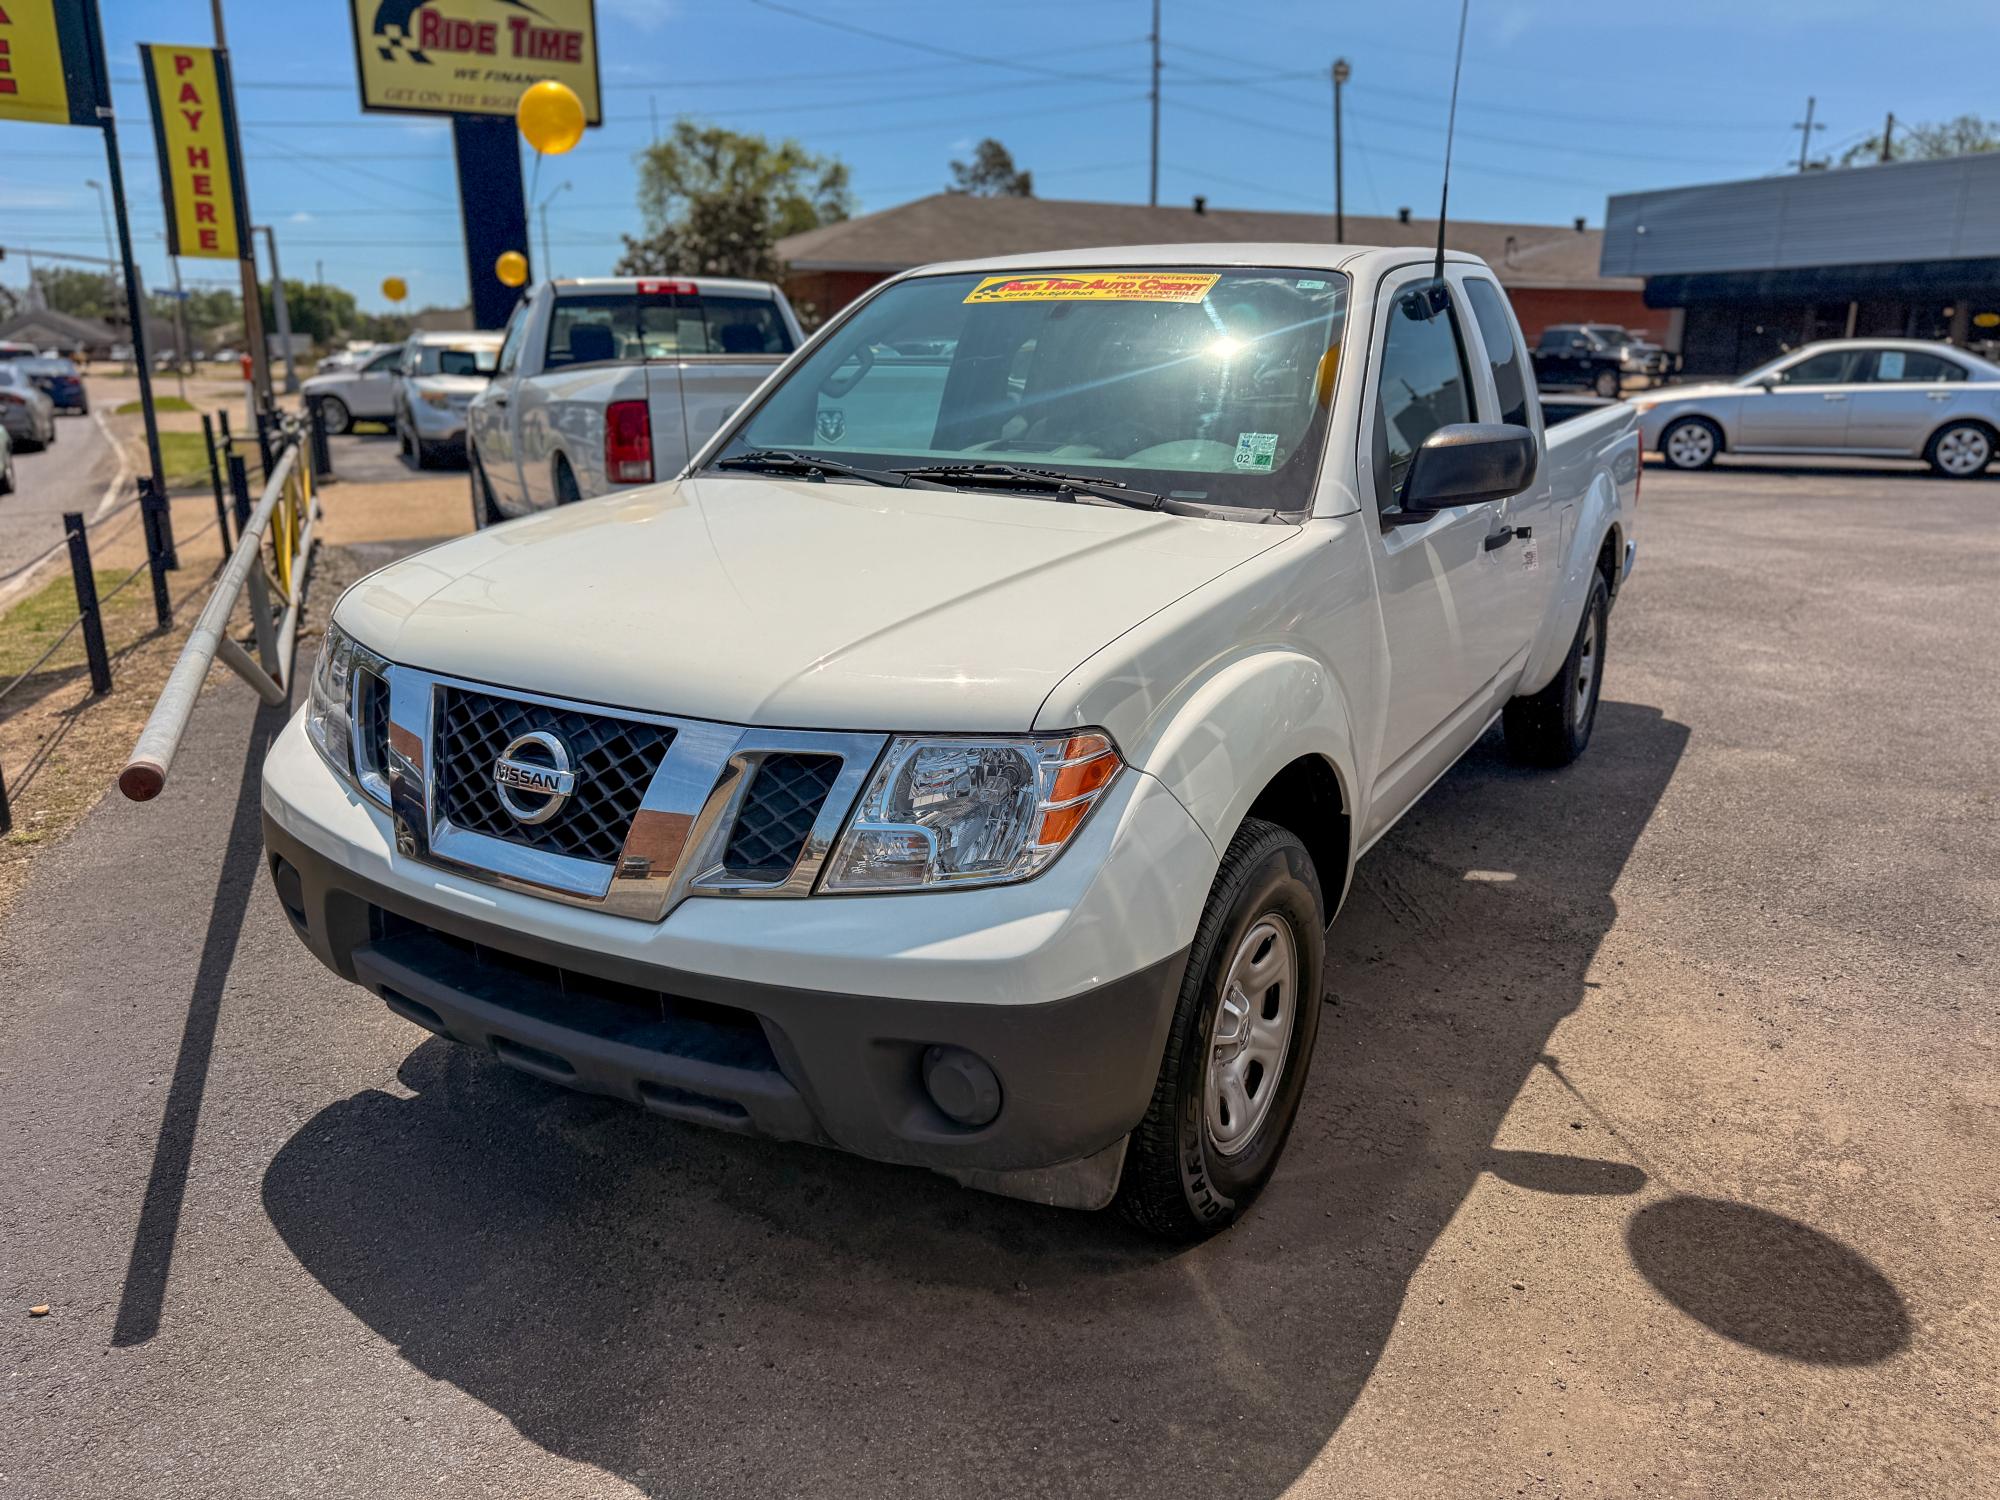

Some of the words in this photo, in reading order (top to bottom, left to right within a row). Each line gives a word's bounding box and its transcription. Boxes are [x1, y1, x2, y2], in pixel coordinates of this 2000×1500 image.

[419, 7, 498, 55] RIDE
[507, 14, 584, 64] TIME
[454, 67, 479, 81] WE
[173, 54, 202, 132] PAY
[384, 87, 416, 101] GET
[419, 91, 442, 104] ON
[448, 92, 476, 106] THE
[480, 94, 519, 109] RIGH
[187, 146, 218, 250] HERE
[1082, 279, 1137, 290] AUTO
[1138, 279, 1208, 292] CREDIT
[1236, 454, 1250, 464] 02
[1256, 455, 1270, 465] 27
[497, 764, 560, 790] NISSAN
